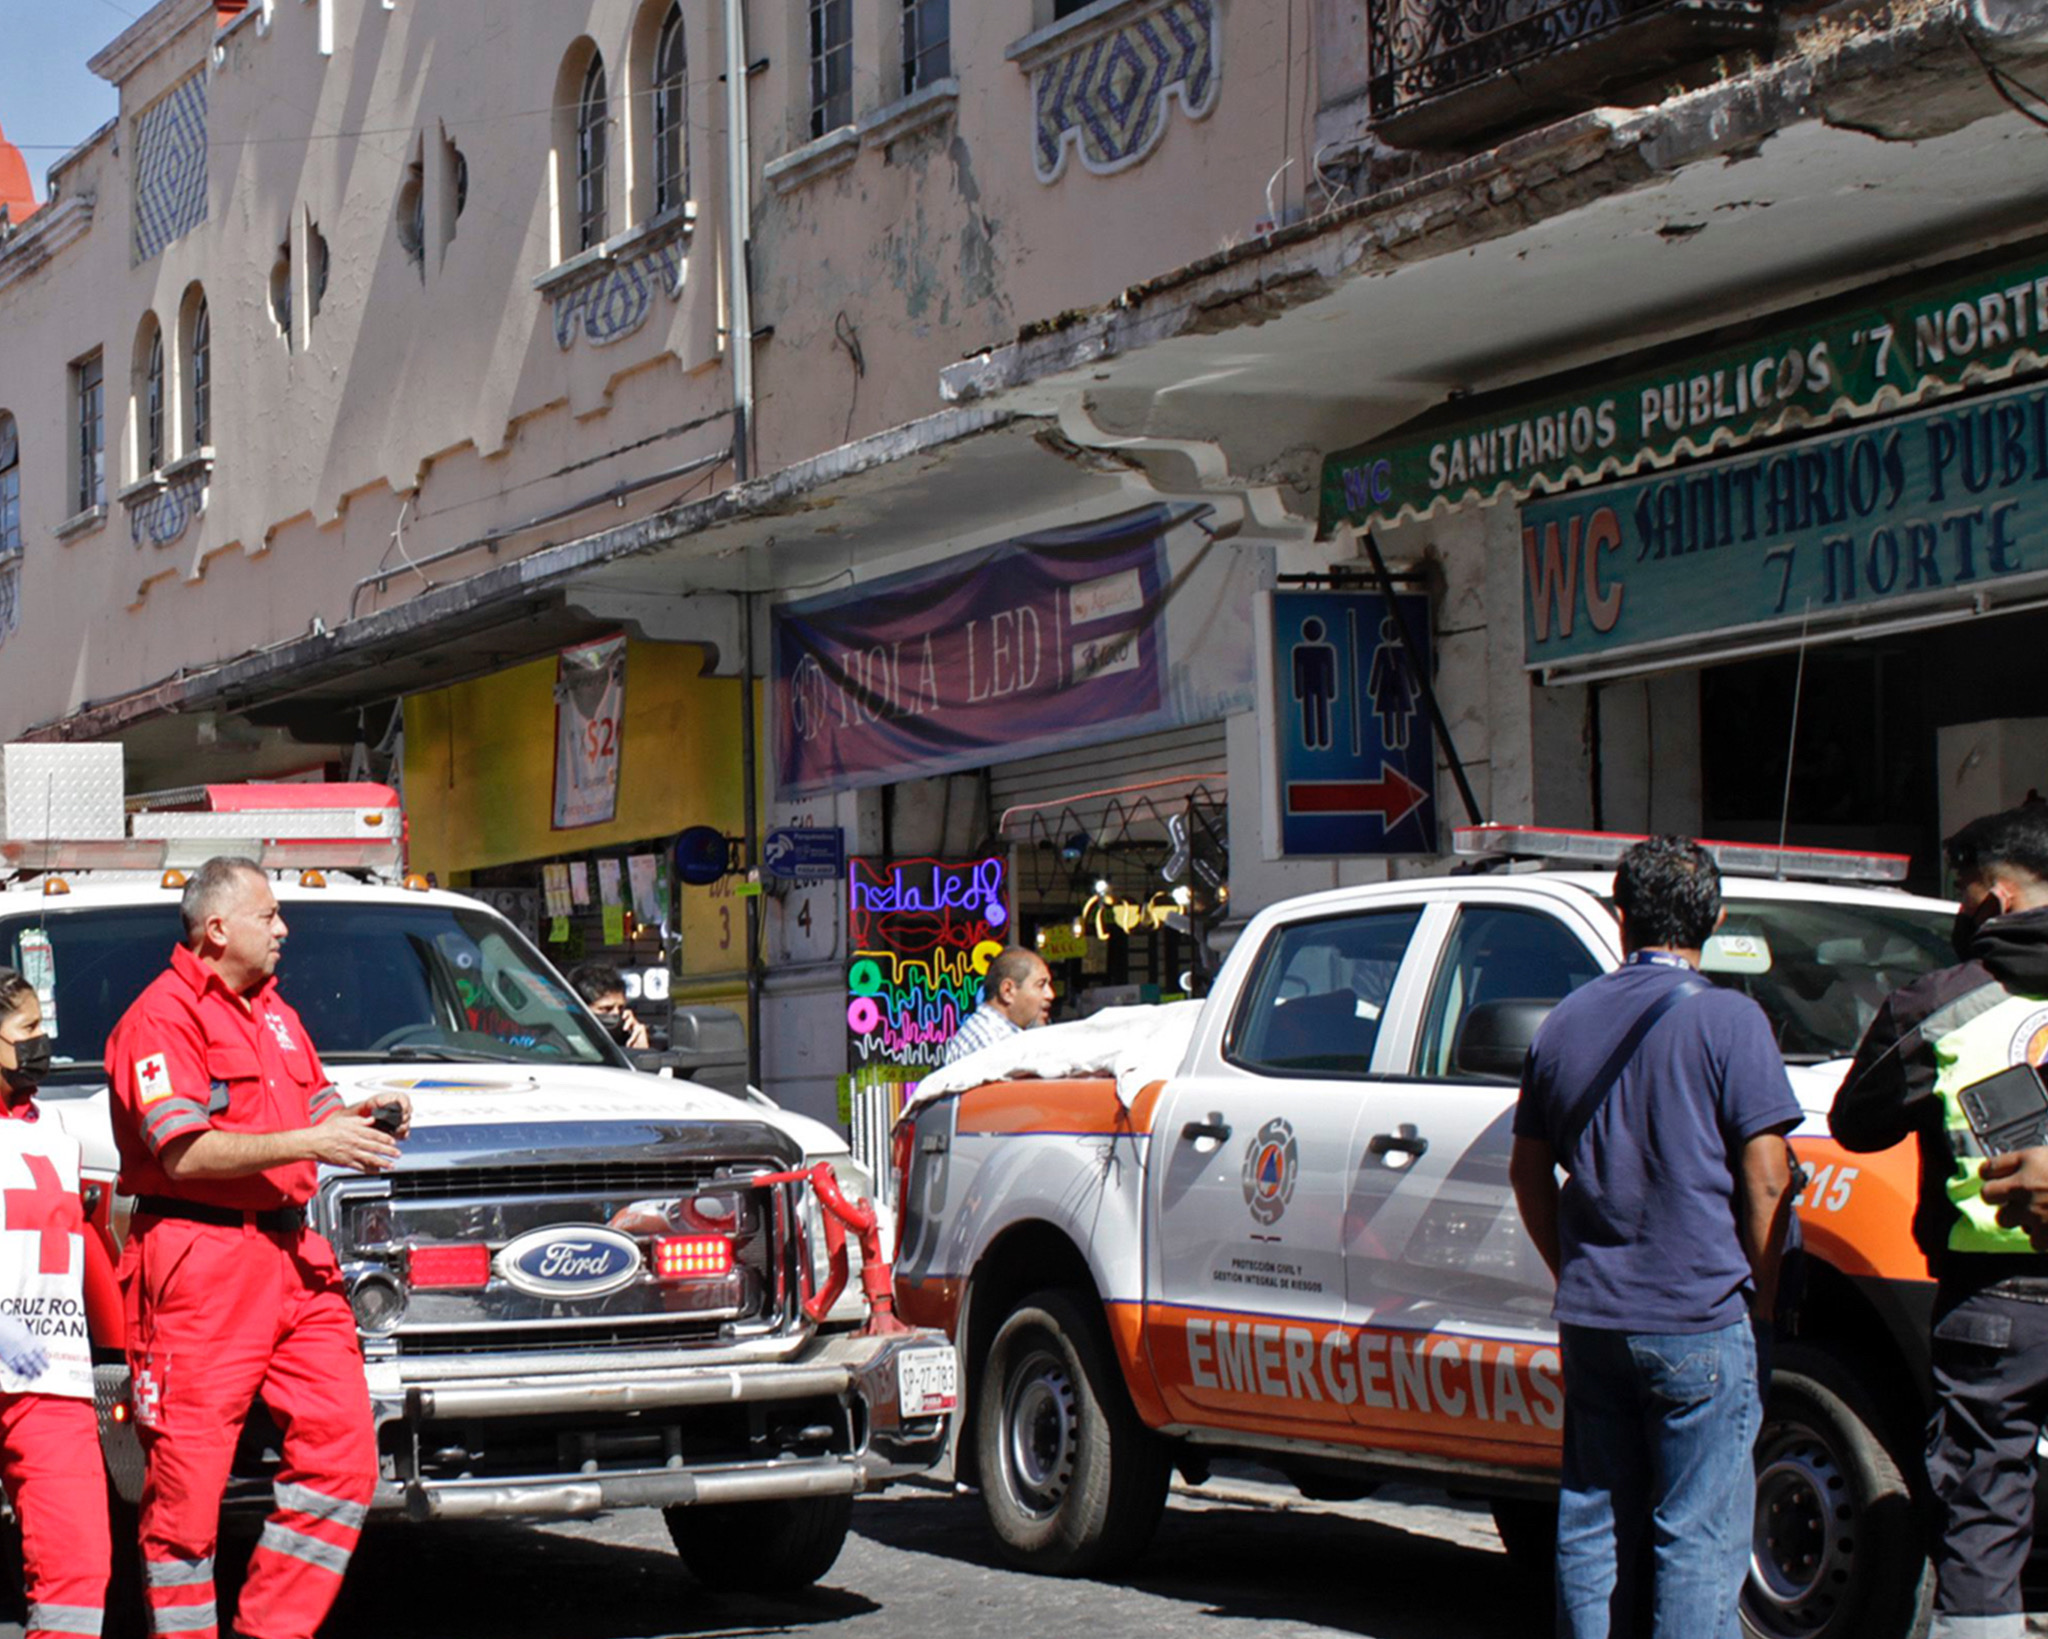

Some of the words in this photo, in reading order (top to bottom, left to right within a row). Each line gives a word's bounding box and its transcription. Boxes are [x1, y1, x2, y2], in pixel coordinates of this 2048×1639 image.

[1342, 459, 1391, 511] WC
[1428, 400, 1616, 490] SANITARIOS
[1640, 341, 1832, 438] PUBLICOS
[1523, 507, 1623, 642] WC
[1762, 543, 1796, 614] 7
[839, 632, 939, 729] HOLA
[966, 606, 1041, 703] LED
[719, 905, 731, 949] 3
[797, 899, 812, 939] 4
[539, 1243, 610, 1277] Ford
[1277, 1263, 1295, 1275] CIVIL
[1280, 1278, 1289, 1289] DE
[0, 1298, 45, 1316] CRUZ
[1186, 1318, 1564, 1430] EMERGENCIAS
